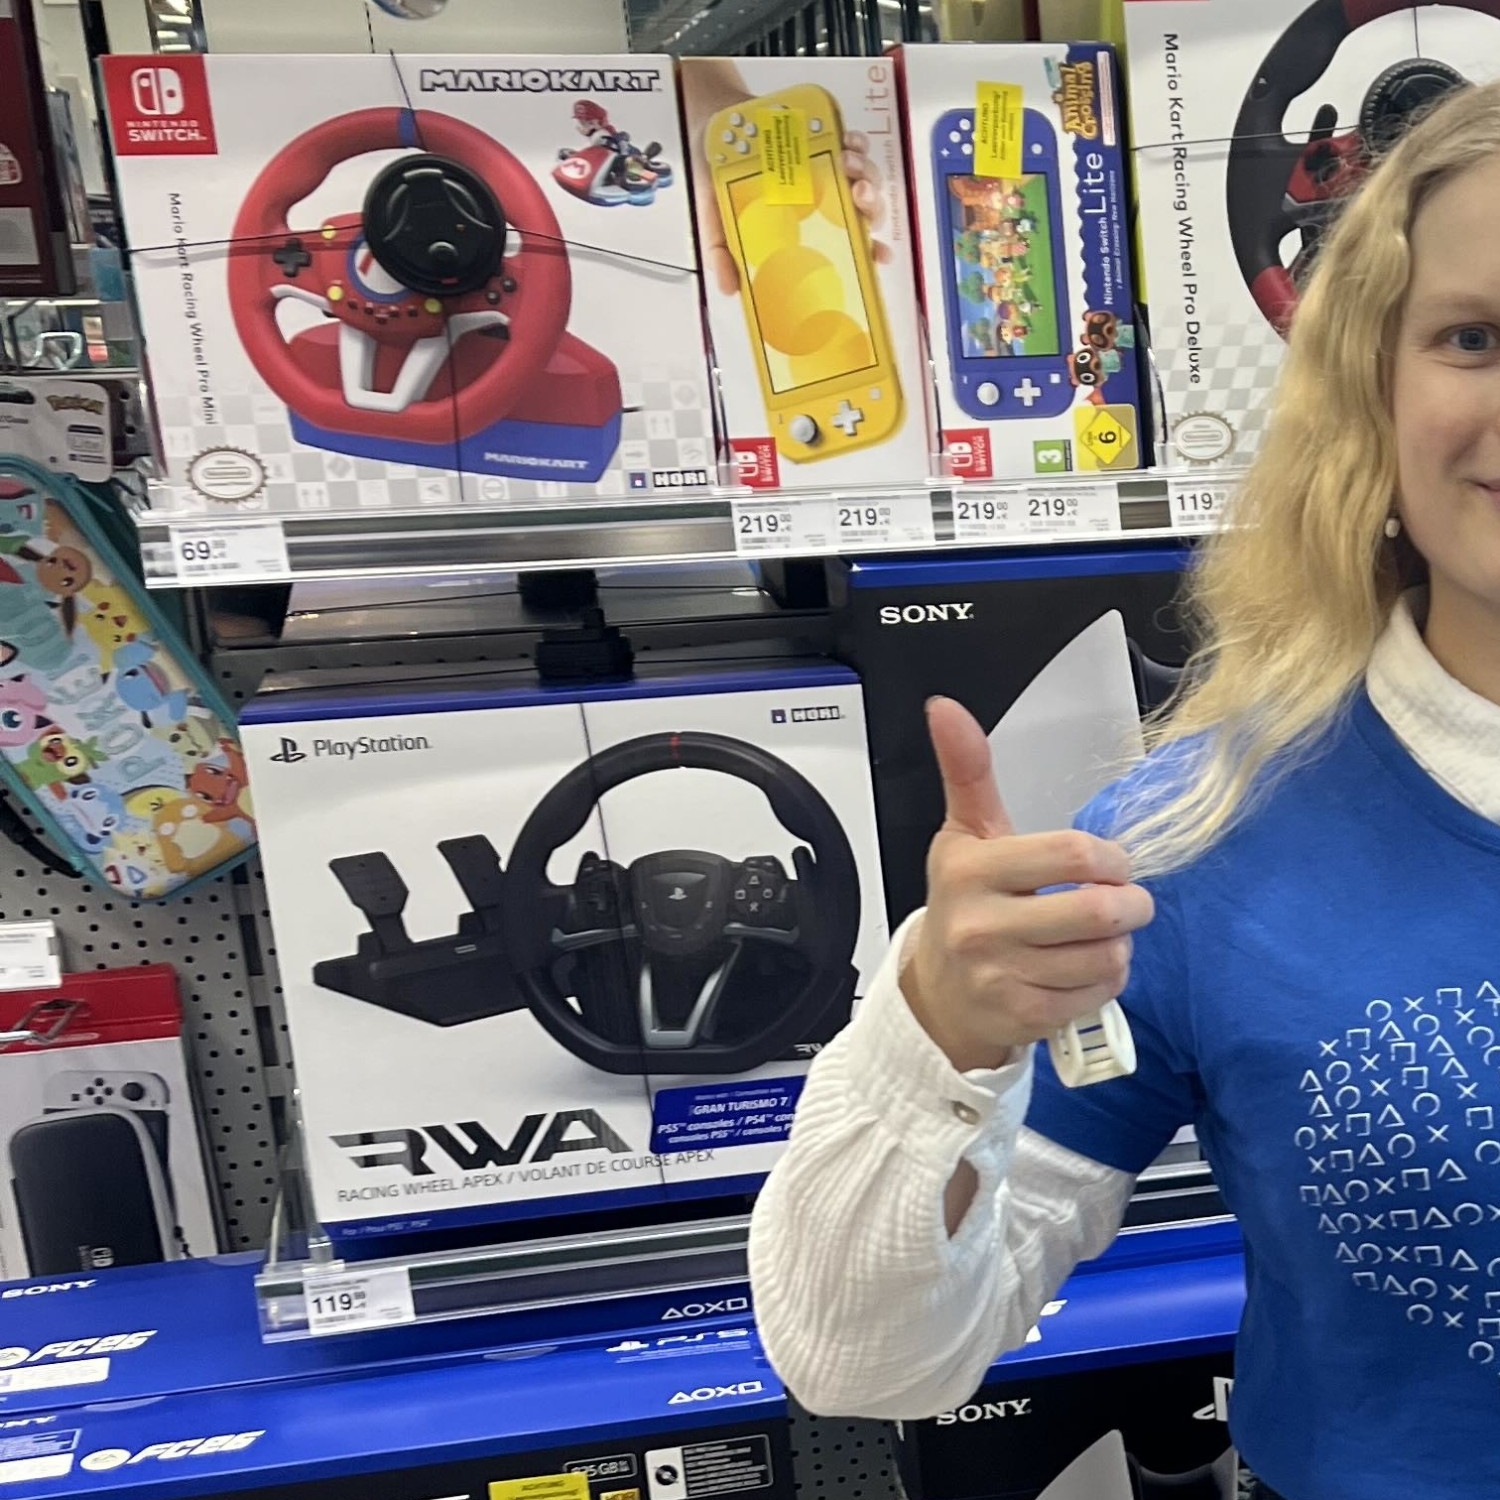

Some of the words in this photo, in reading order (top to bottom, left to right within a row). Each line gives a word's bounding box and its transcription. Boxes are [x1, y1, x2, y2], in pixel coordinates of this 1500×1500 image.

[1163, 33, 1178, 91] Mario
[865, 65, 892, 134] Lite
[126, 120, 198, 128] NINTENDO
[1168, 96, 1184, 141] Kart
[128, 129, 202, 142] SWITCH
[1083, 152, 1107, 213] Lite
[1173, 147, 1188, 212] Racing
[169, 192, 182, 234] Mario
[1098, 217, 1109, 253] Switch
[1178, 216, 1197, 278] Wheel
[177, 238, 189, 269] Kart
[1102, 257, 1114, 304] Nintendo
[181, 272, 197, 319] Racing
[1183, 282, 1197, 315] Pro
[190, 323, 208, 366] Wheel
[1186, 320, 1202, 384] Deluxe
[197, 368, 209, 393] Pro
[202, 396, 218, 425] Mini
[653, 470, 707, 487] HORI
[958, 501, 995, 520] 219
[1028, 498, 1065, 517] 219
[1176, 492, 1213, 510] 119
[740, 515, 778, 533] 219
[839, 507, 877, 526] 219
[181, 541, 210, 560] 69
[879, 603, 974, 625] SONY
[313, 733, 430, 760] PlayStation
[693, 1102, 725, 1116] GRAN
[728, 1098, 777, 1112] TURISMO
[668, 1133, 709, 1144] consoles
[742, 1126, 782, 1136] consoles
[686, 1119, 734, 1131] consoles
[774, 1113, 796, 1122] con
[330, 1109, 633, 1176] RWA
[338, 1184, 399, 1202] RACING
[404, 1178, 457, 1195] WHEEL
[462, 1172, 504, 1190] APEX
[519, 1165, 583, 1183] VOLANT
[587, 1159, 606, 1175] DE
[610, 1154, 671, 1172] COURSE
[675, 1149, 716, 1164] APEX
[2, 1279, 97, 1299] SONY
[313, 1293, 352, 1314] 119
[936, 1399, 1030, 1426] SONY
